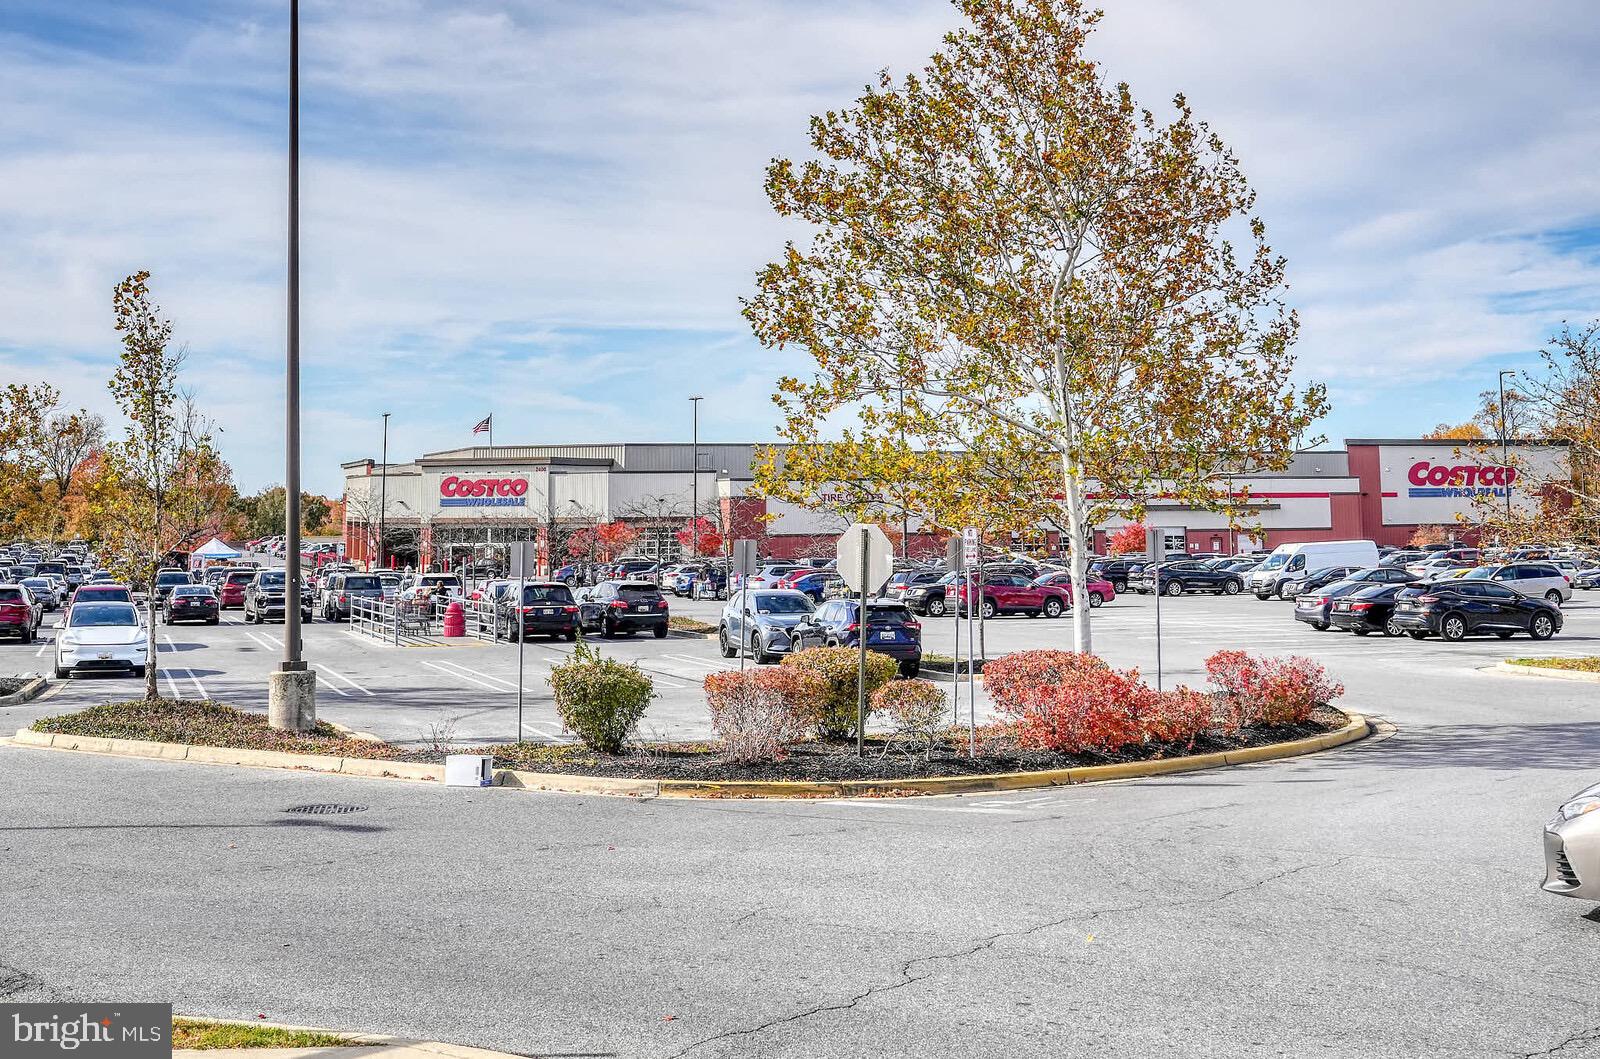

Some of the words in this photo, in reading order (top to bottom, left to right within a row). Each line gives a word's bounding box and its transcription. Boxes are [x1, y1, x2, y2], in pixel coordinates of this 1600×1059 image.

[1408, 461, 1516, 486] COSTCO
[440, 476, 528, 497] COSTCO
[466, 497, 526, 507] WHOLESALE
[822, 493, 843, 502] TIRE
